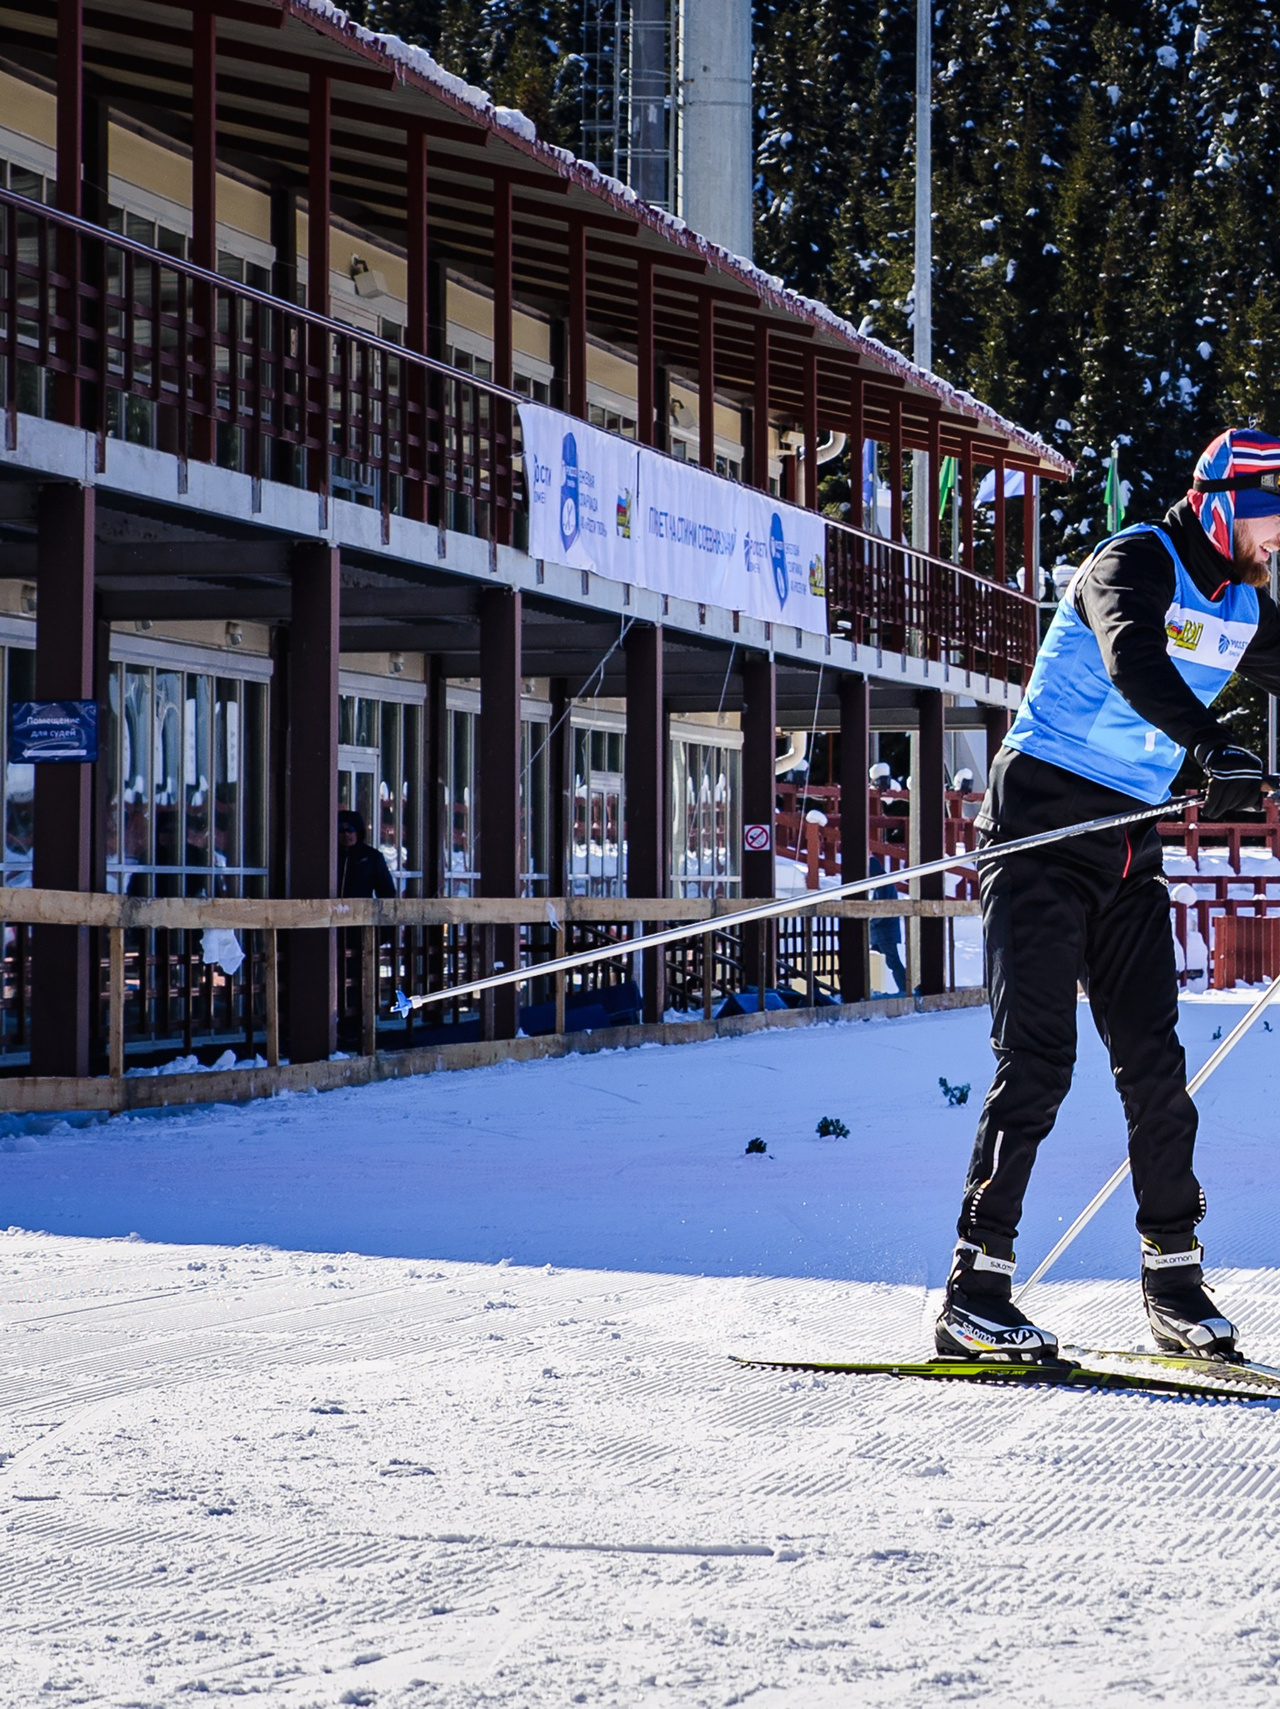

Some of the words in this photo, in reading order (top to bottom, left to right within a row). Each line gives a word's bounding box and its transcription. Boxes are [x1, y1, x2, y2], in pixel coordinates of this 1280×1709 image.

[26, 716, 81, 726] Помещение
[30, 730, 48, 738] для
[49, 728, 76, 738] судей
